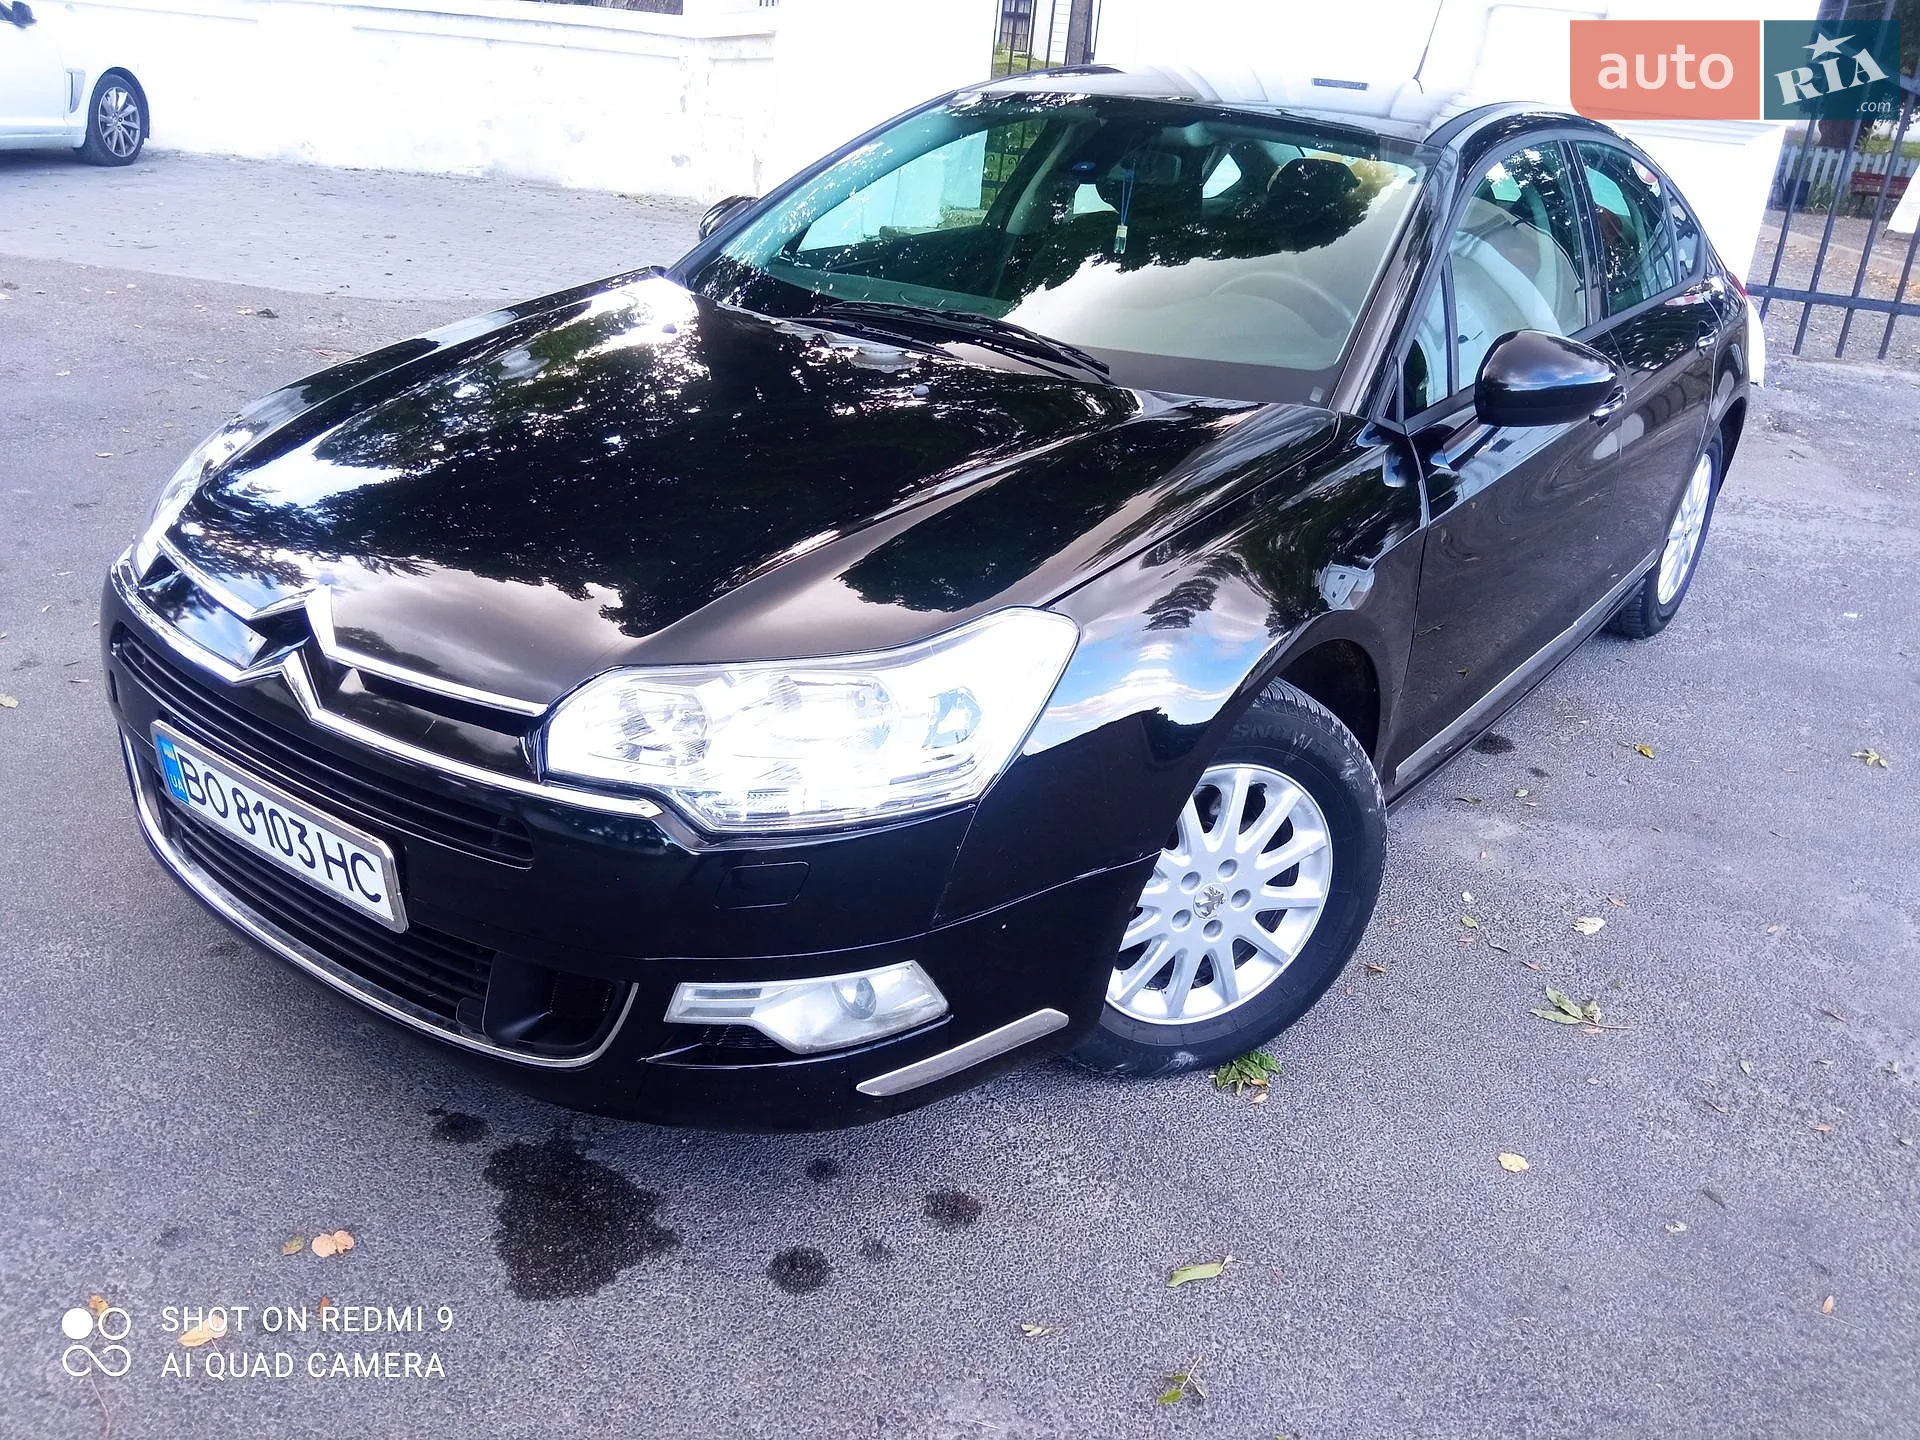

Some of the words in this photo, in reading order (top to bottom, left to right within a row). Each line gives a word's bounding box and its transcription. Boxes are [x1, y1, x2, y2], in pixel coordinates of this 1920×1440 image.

[169, 774, 186, 793] UA
[177, 752, 229, 819] BO
[231, 787, 316, 869] 8103
[316, 832, 382, 903] HC
